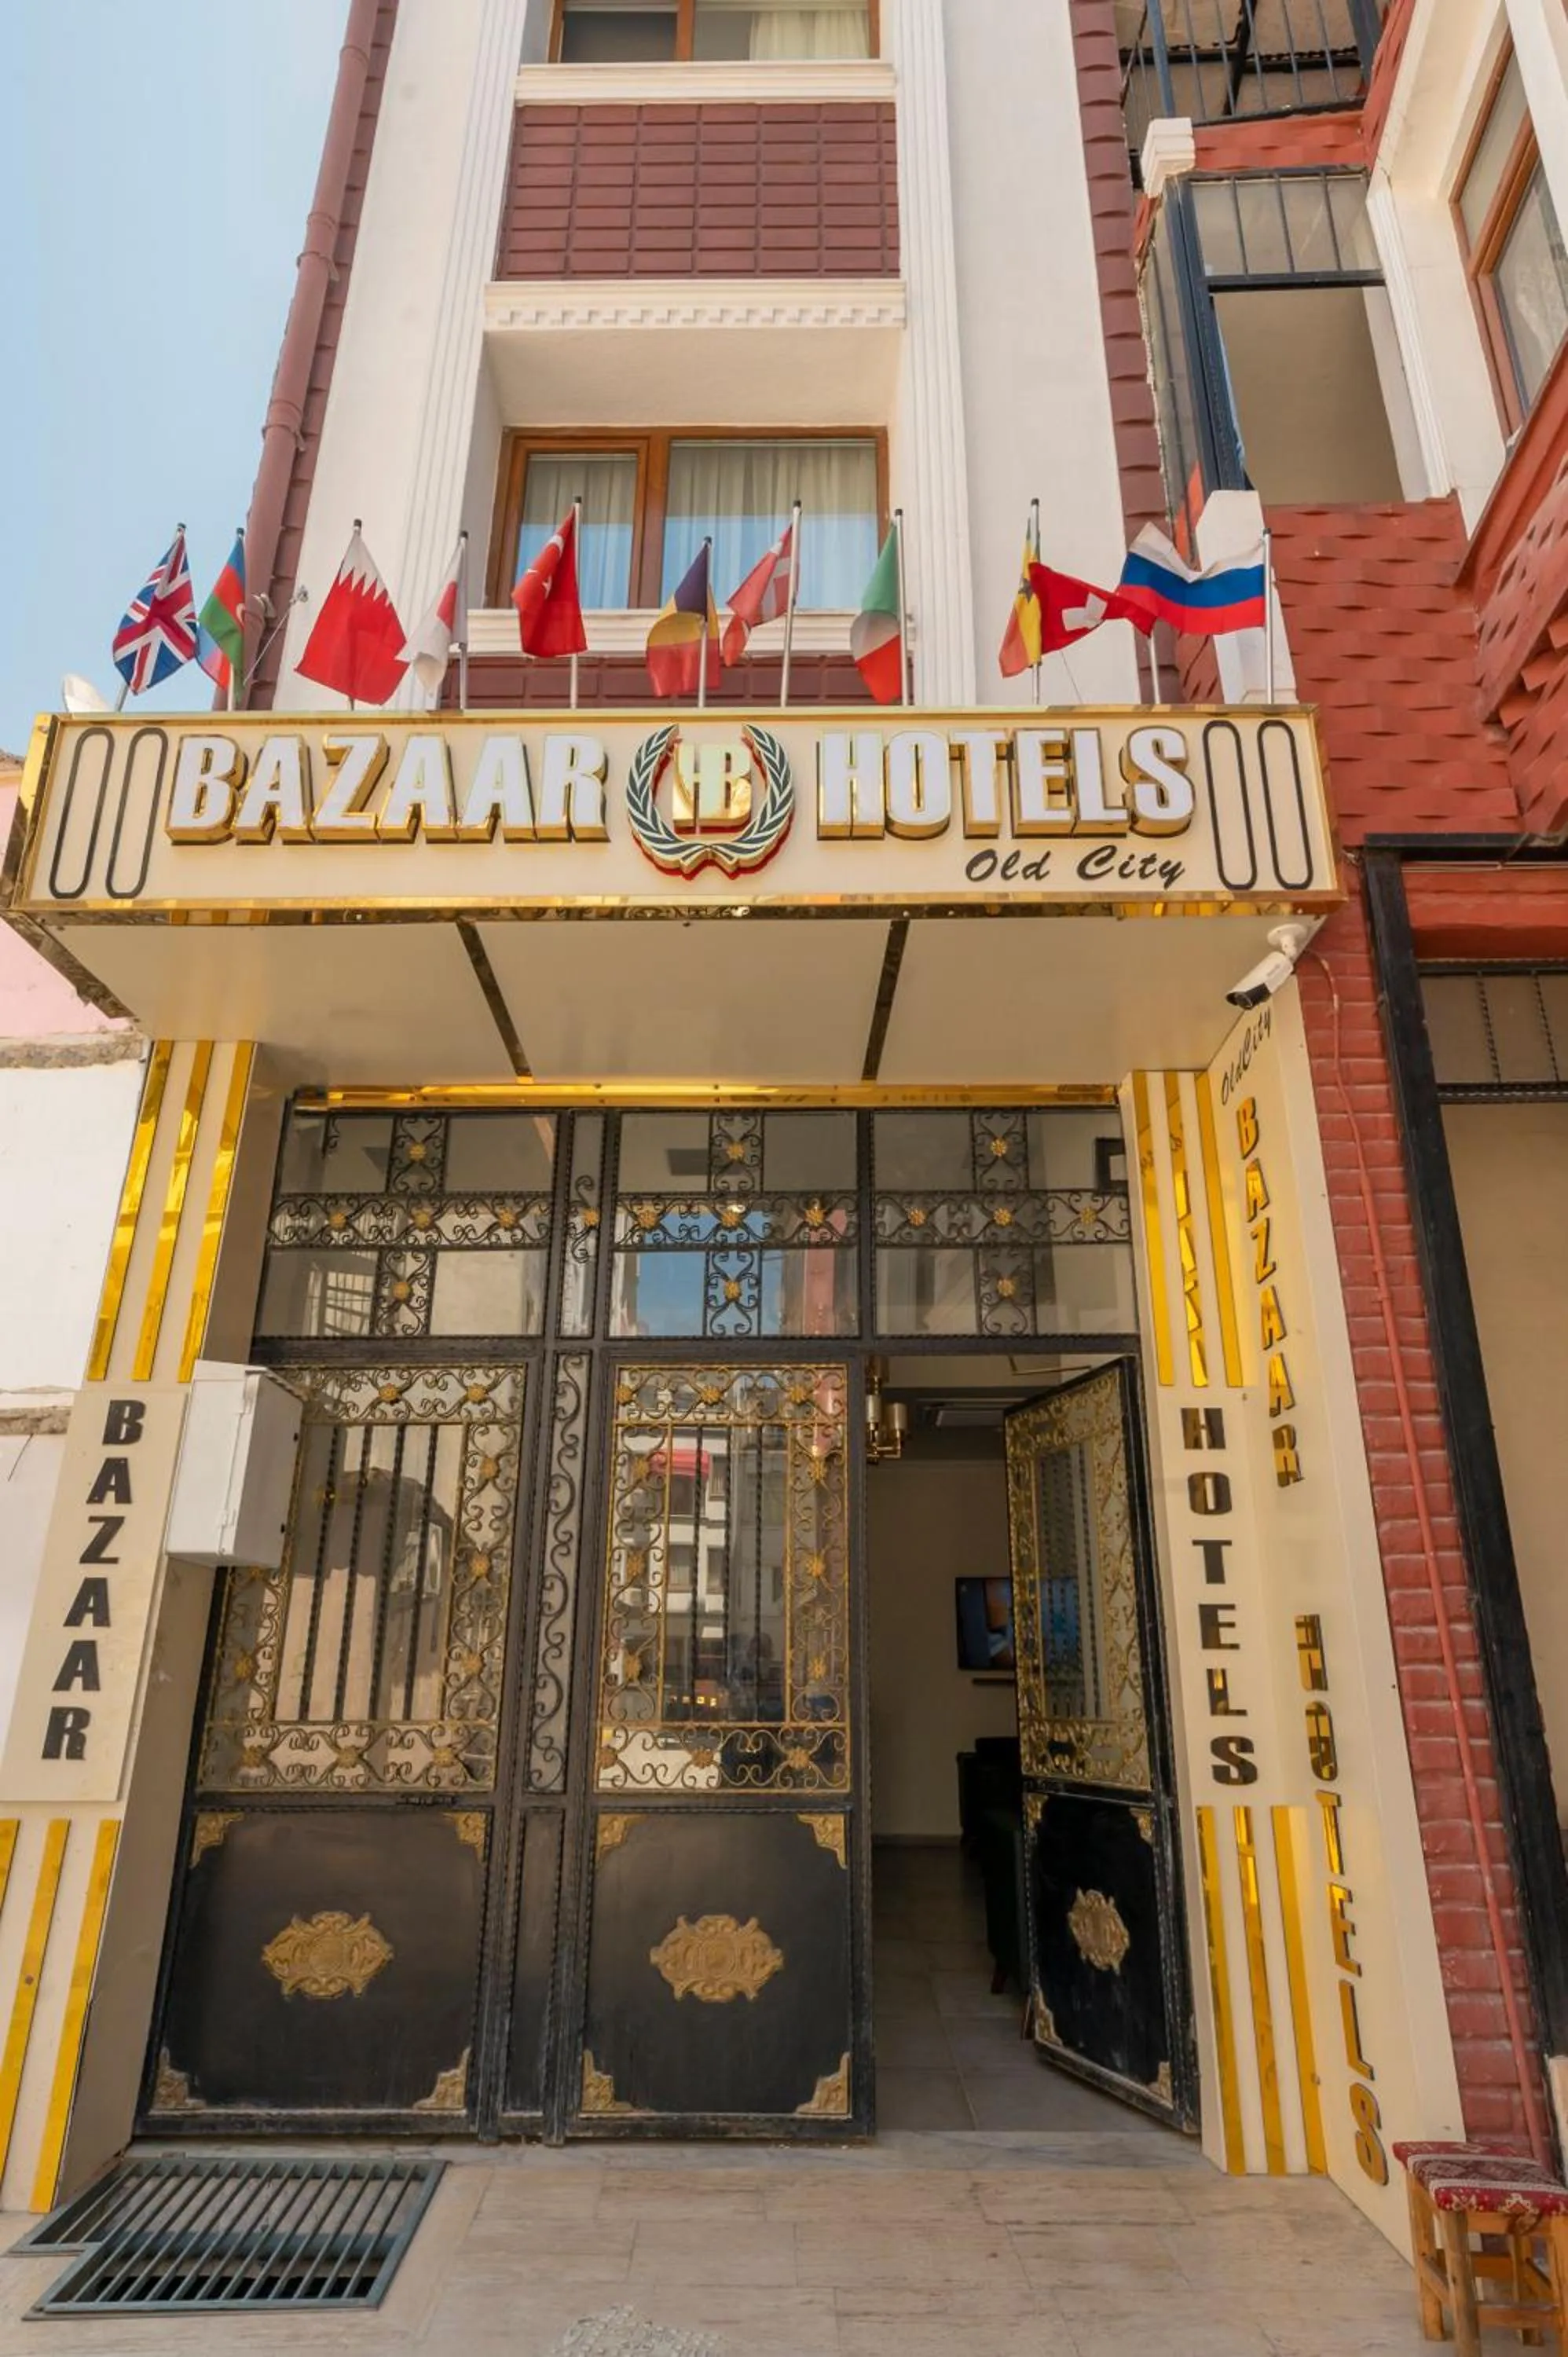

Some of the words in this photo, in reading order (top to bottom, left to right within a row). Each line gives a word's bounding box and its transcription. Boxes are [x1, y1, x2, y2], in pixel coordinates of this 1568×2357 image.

[164, 732, 611, 845] BAZAAR
[816, 725, 1196, 841] HOTELS
[965, 848, 1051, 882] Old
[1076, 844, 1185, 889] City
[1236, 1096, 1304, 1489] BAZAAR
[41, 1398, 144, 1761] BAZAAR
[1180, 1406, 1258, 1787] HOTELS
[1294, 1613, 1390, 2187] HOTELS
